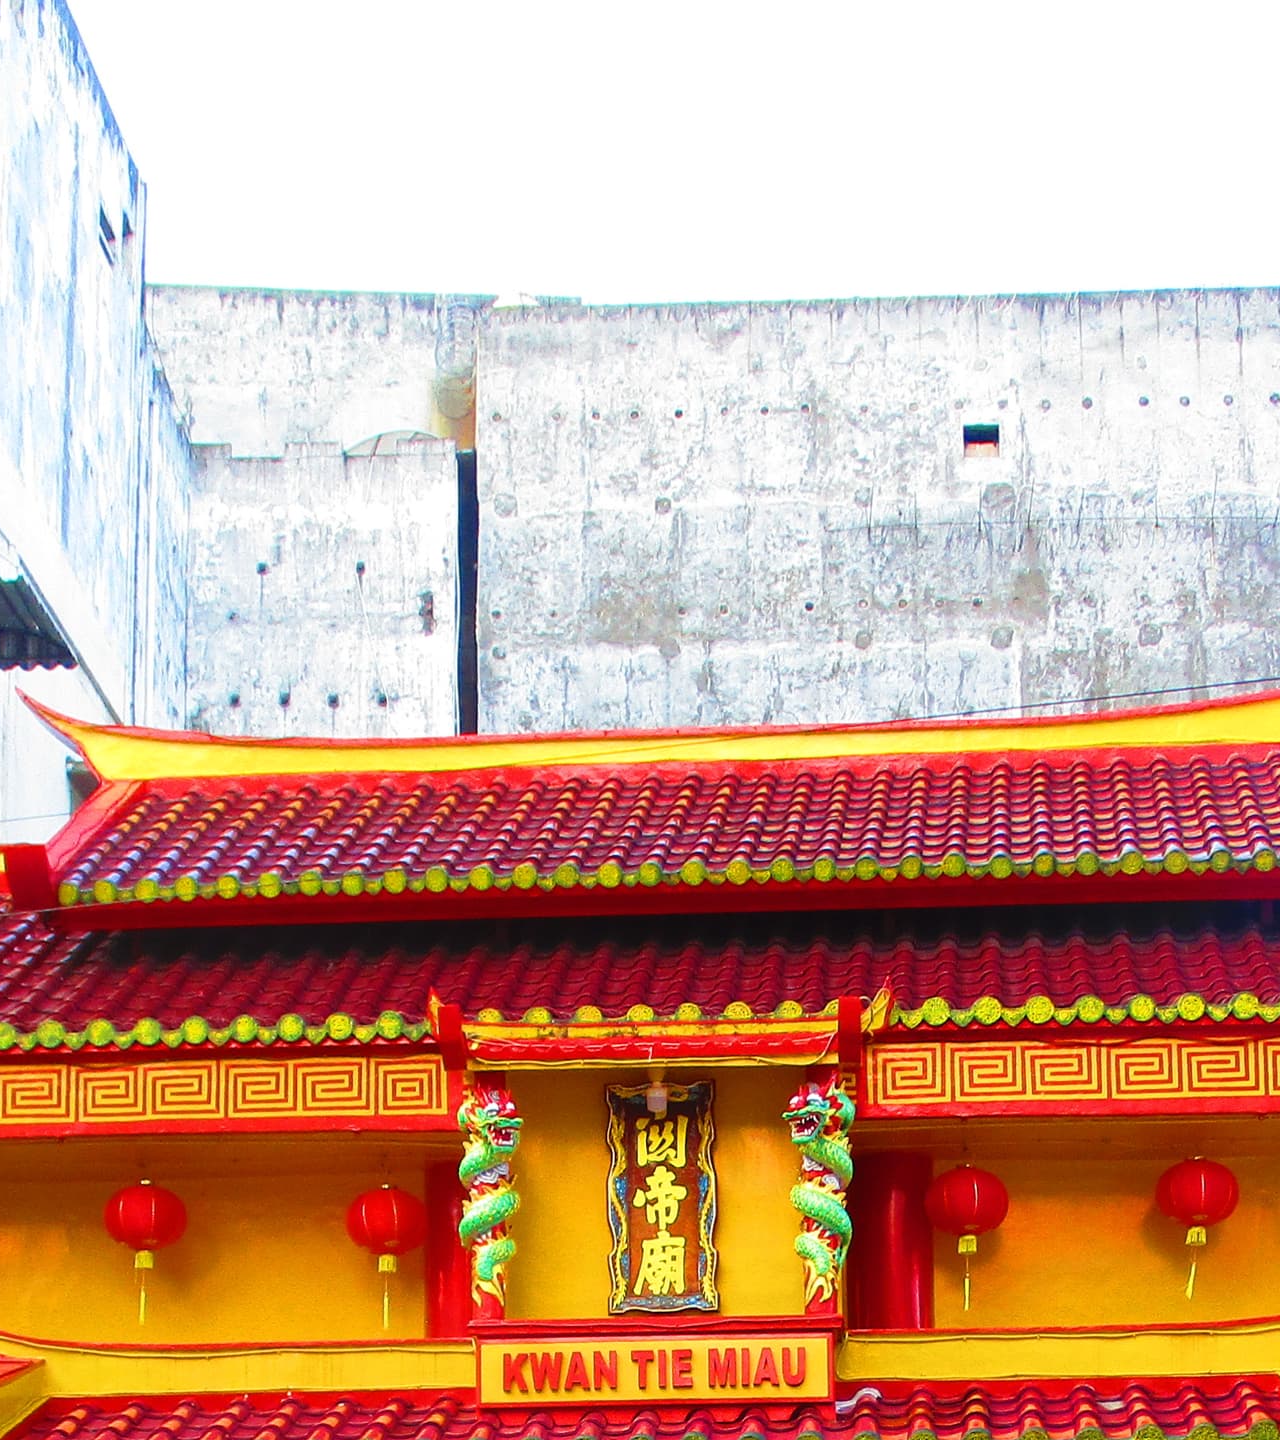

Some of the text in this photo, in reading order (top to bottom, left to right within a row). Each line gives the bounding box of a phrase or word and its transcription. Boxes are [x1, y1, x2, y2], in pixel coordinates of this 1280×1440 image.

[503, 1347, 806, 1392] KWAN TIE MIAU
